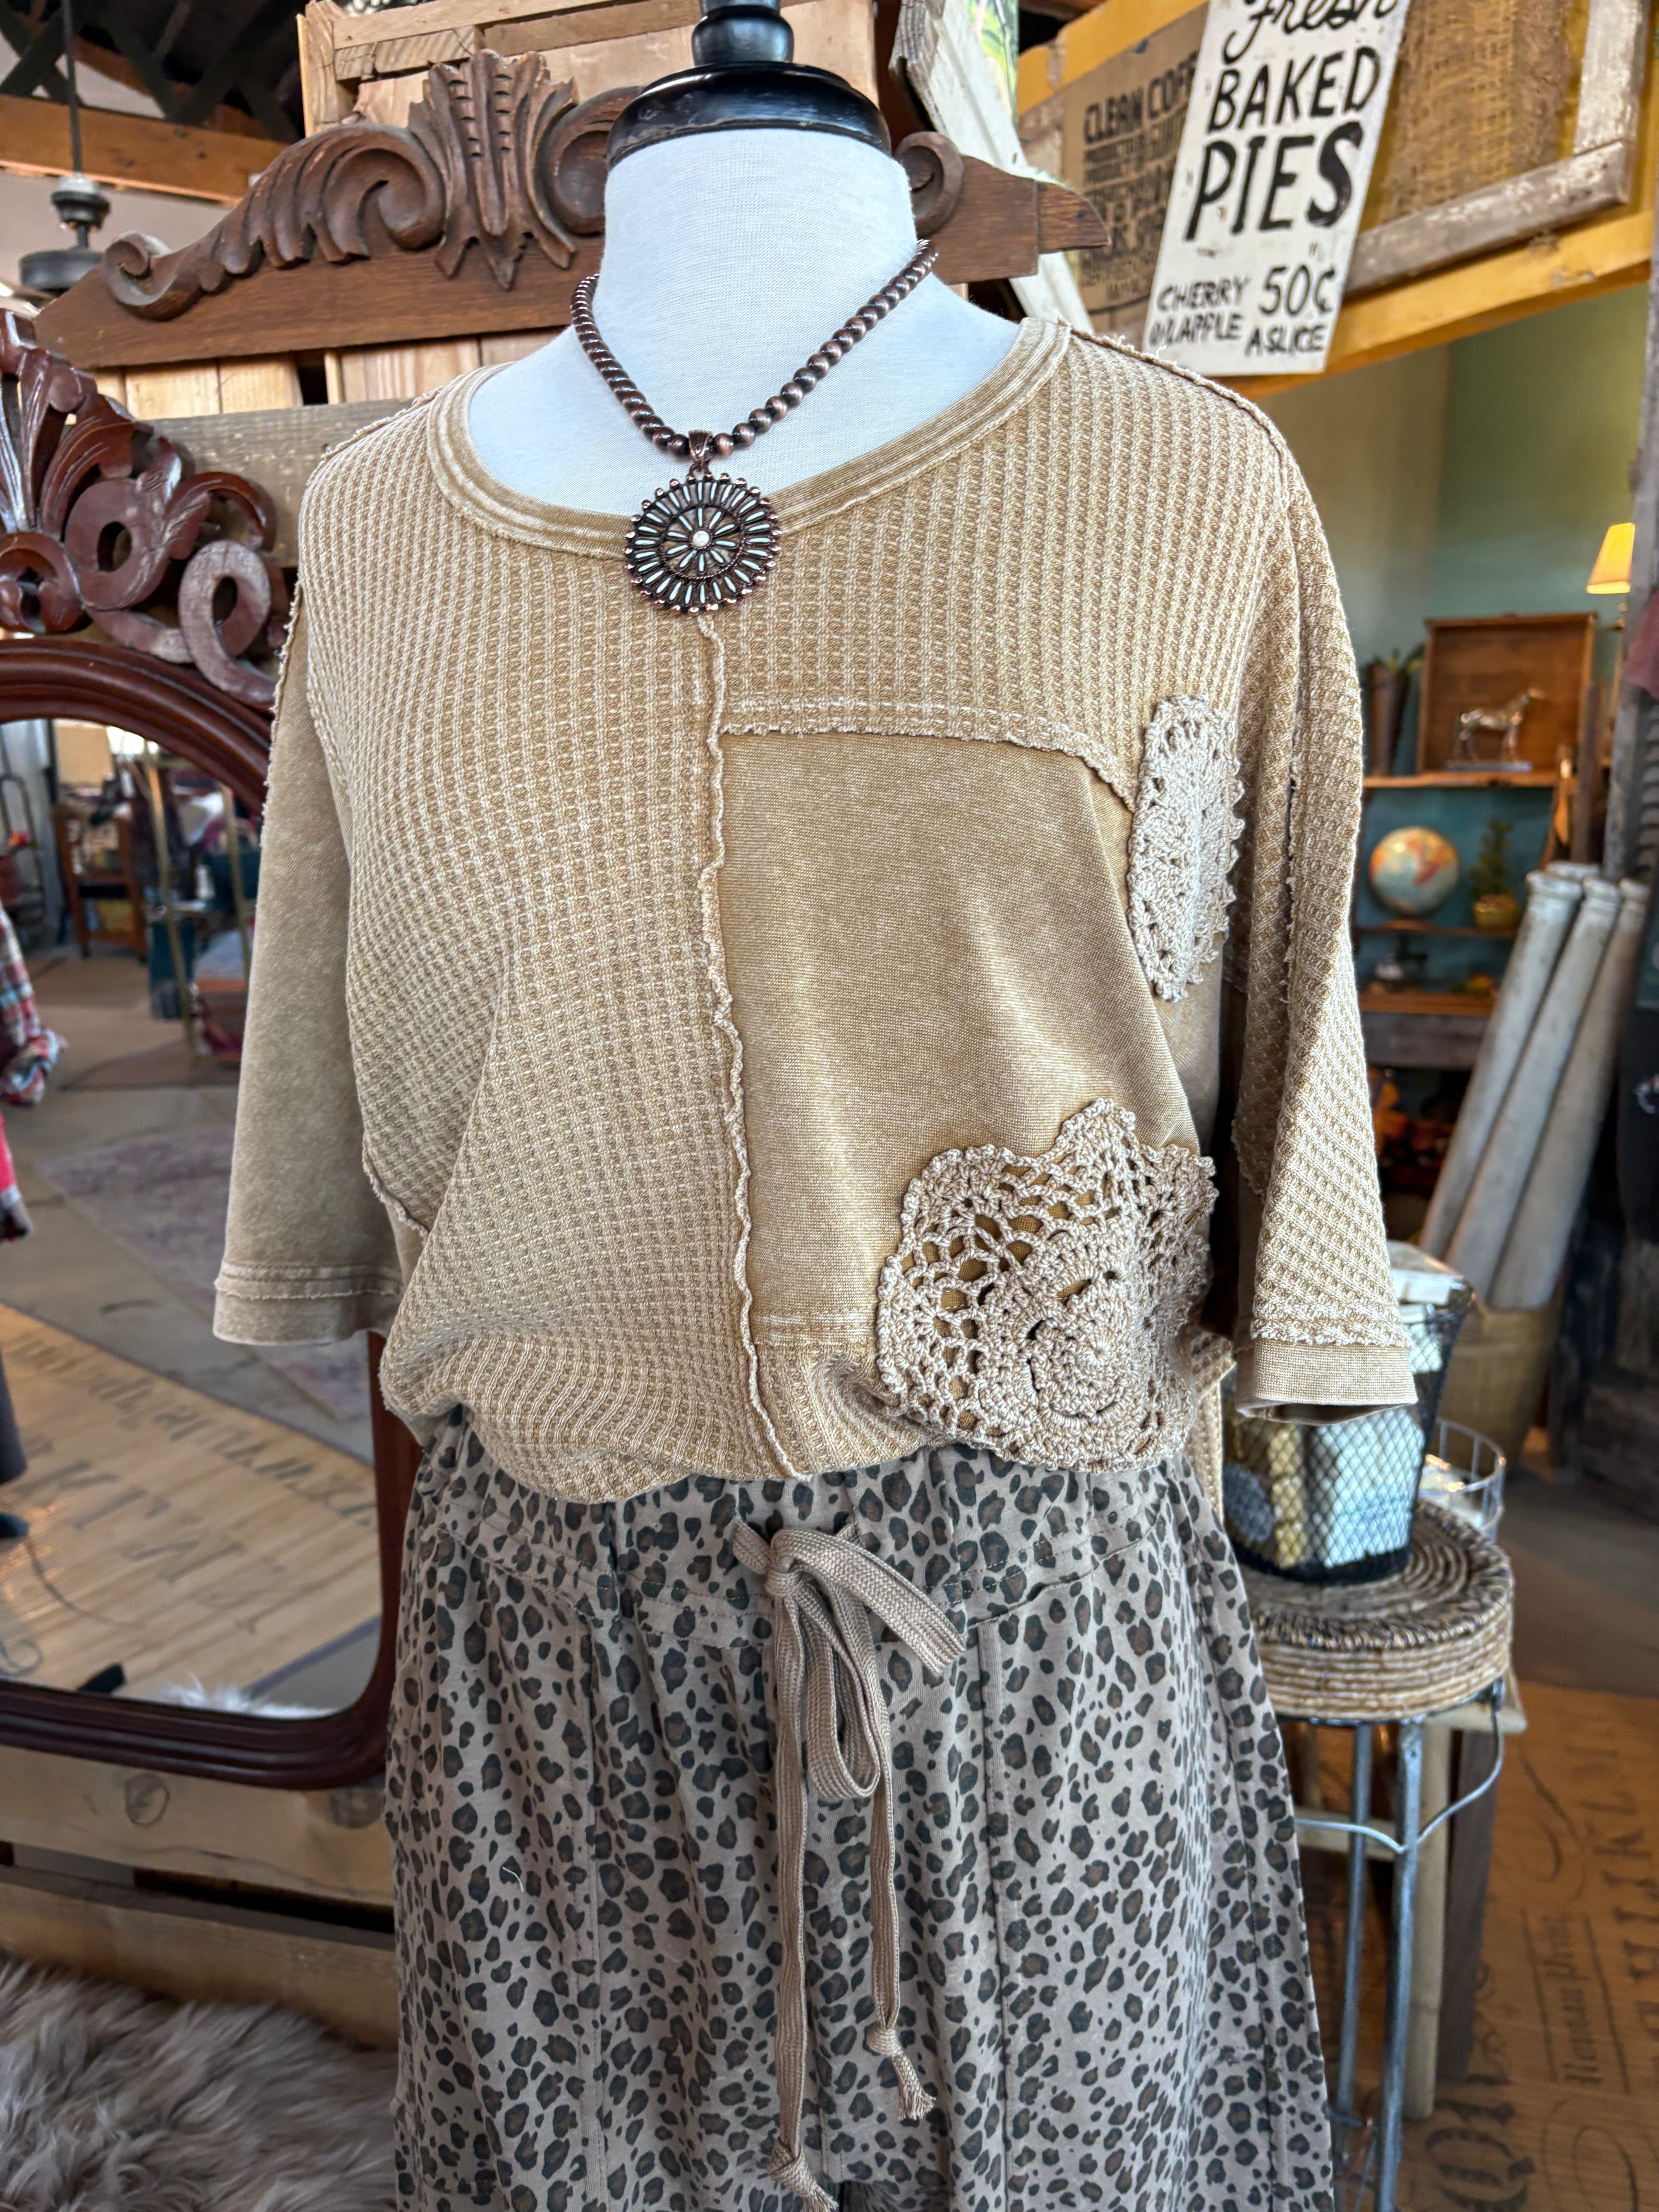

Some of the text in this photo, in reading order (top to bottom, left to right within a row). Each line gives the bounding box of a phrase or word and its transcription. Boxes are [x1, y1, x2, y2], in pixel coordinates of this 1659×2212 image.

[1207, 46, 1380, 132] BAKED
[1186, 121, 1364, 241] PIES
[1156, 274, 1251, 311] CHERRY
